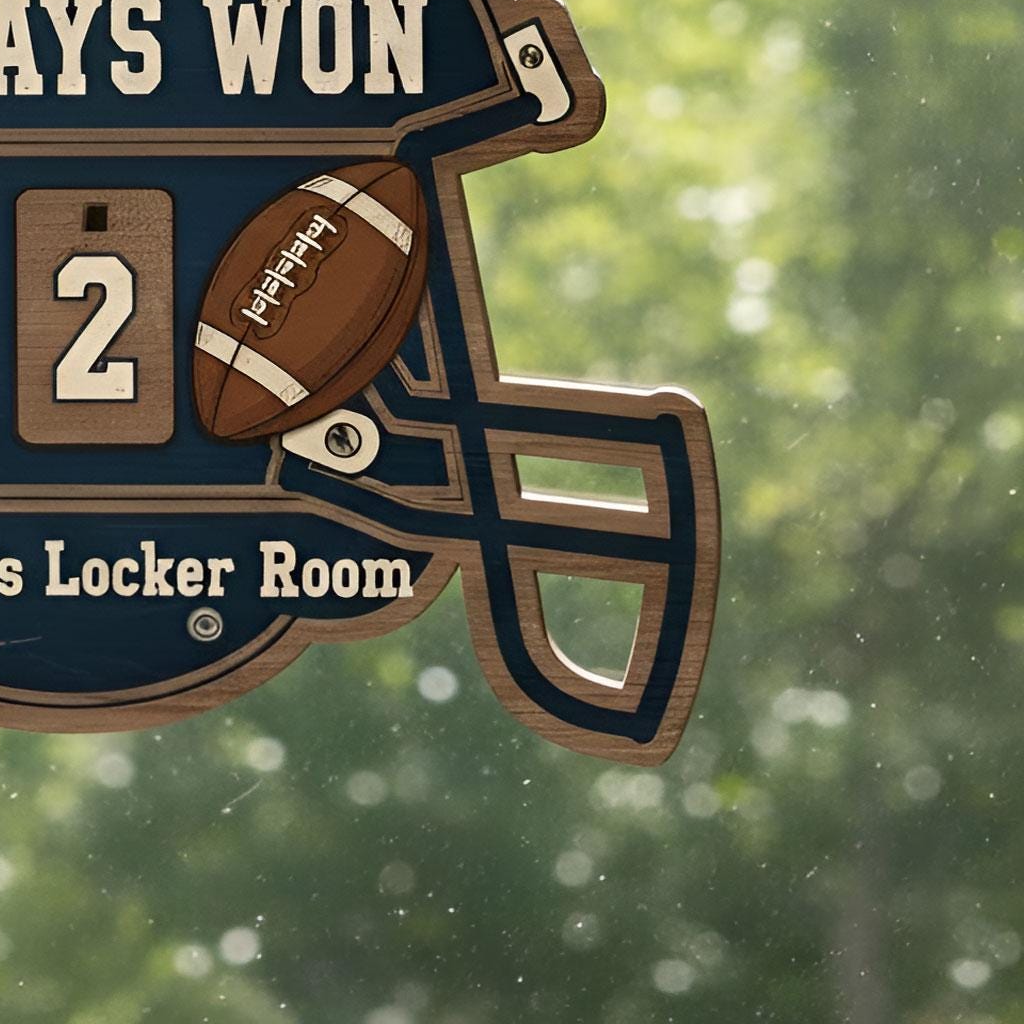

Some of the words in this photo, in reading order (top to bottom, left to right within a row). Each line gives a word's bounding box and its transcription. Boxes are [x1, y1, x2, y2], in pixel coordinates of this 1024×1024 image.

[55, 255, 135, 401] 2
[43, 538, 236, 598] Locker
[259, 539, 415, 599] Room
